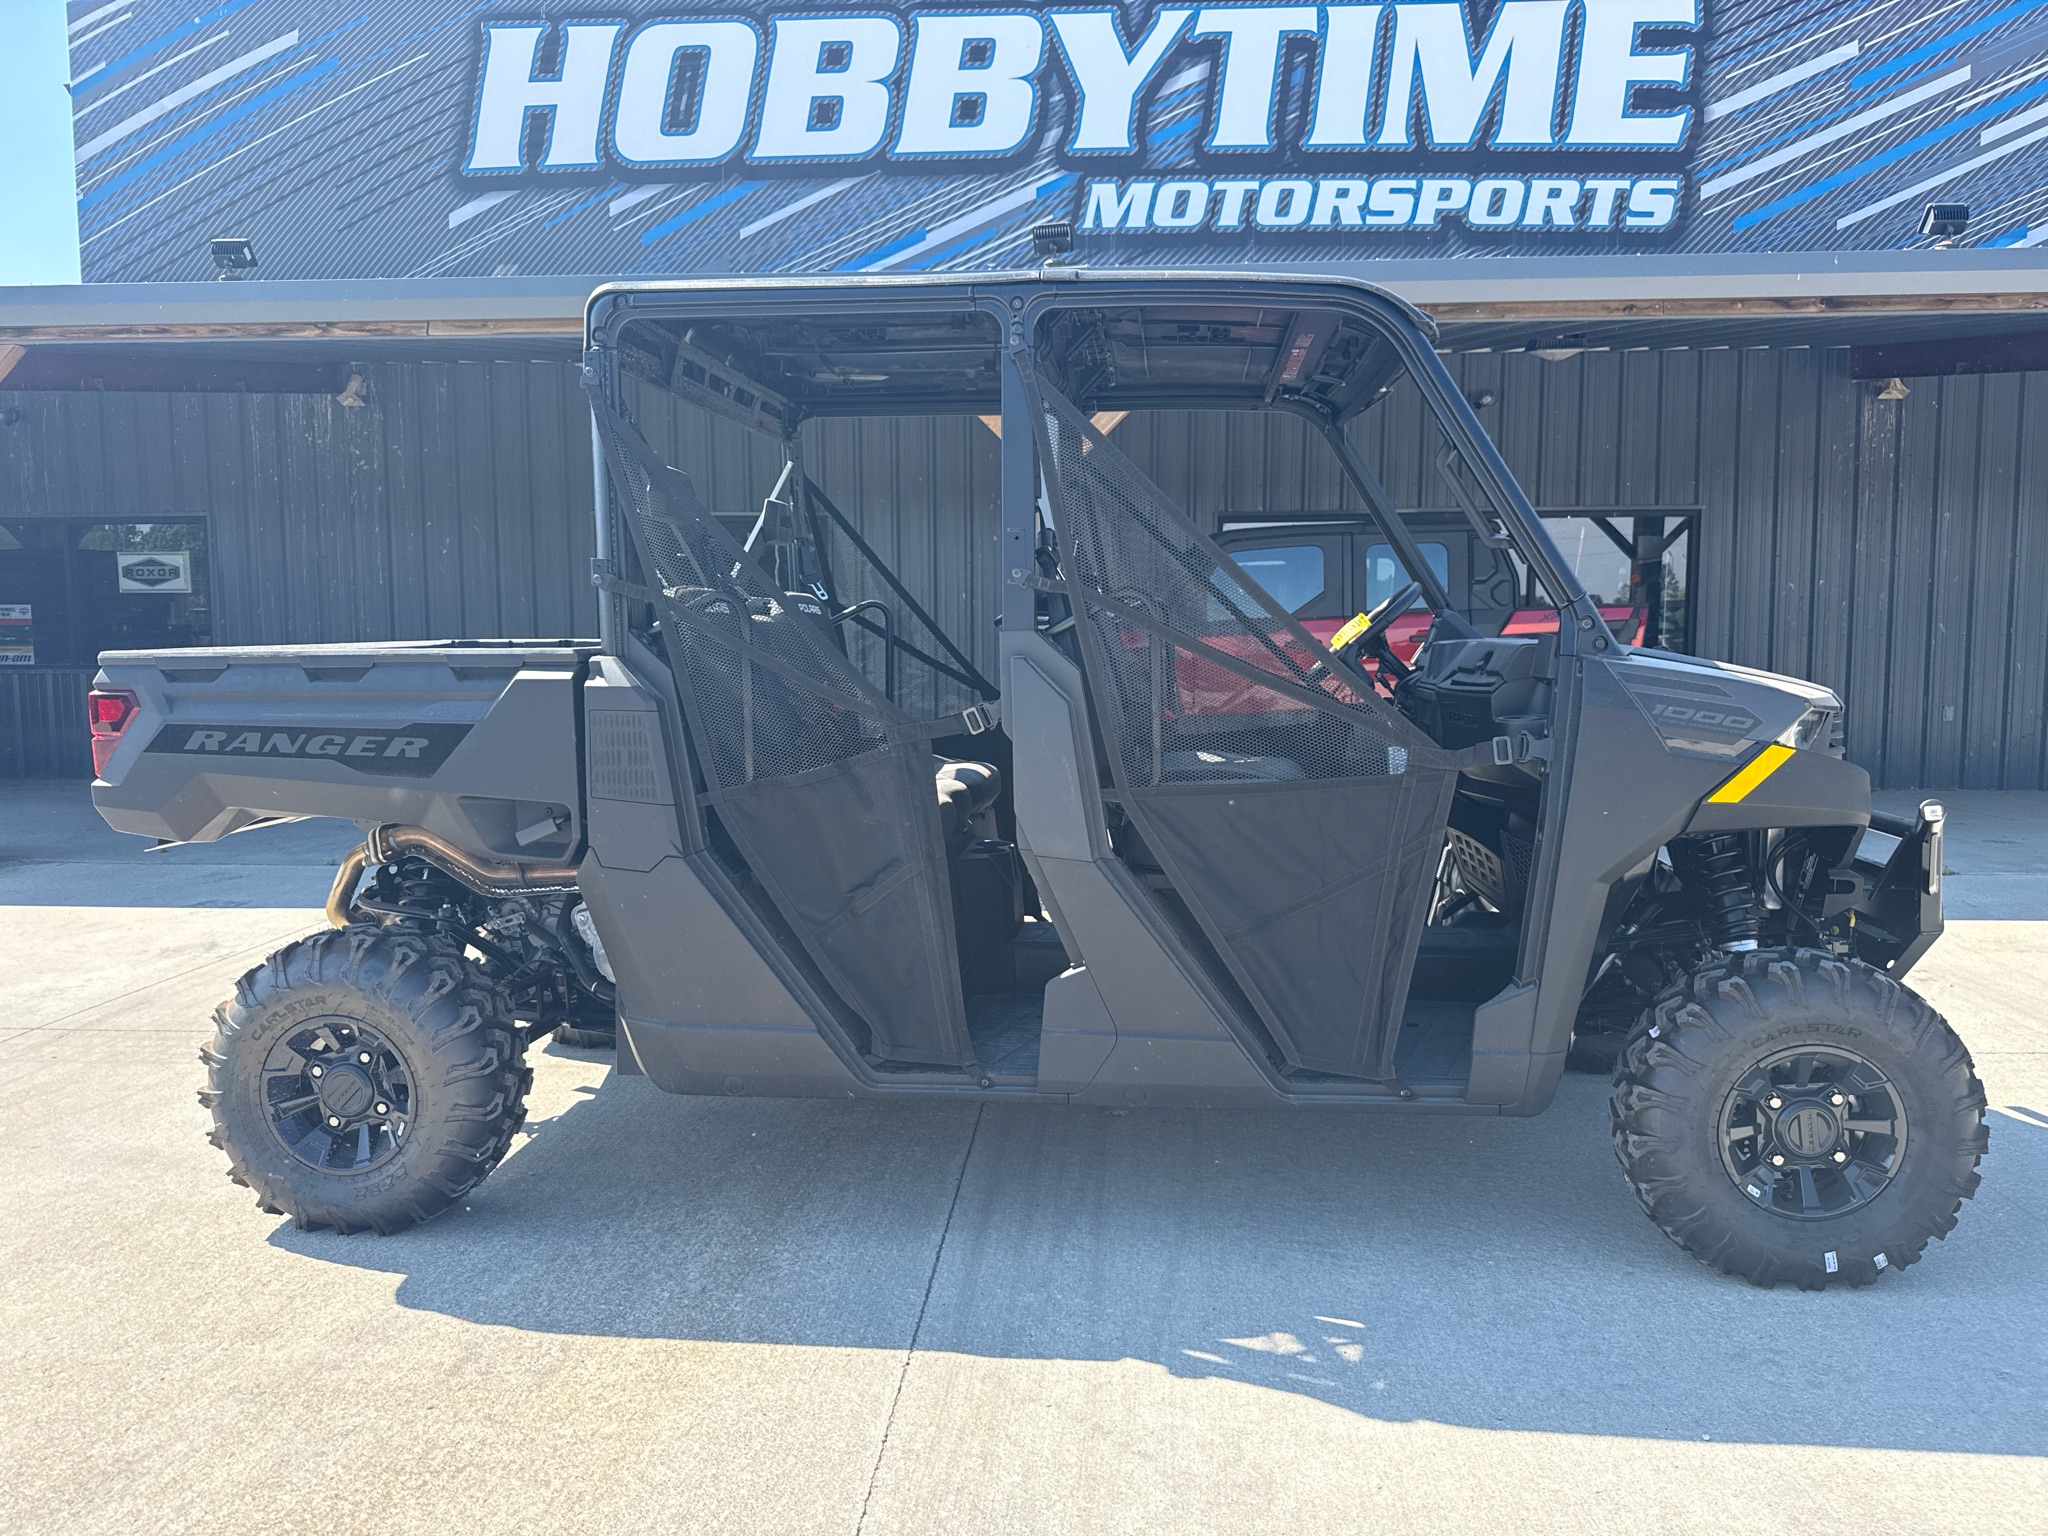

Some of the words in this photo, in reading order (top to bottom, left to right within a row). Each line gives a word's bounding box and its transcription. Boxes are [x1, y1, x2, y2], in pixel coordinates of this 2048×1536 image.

[463, 0, 1697, 170] HOBBYTIME
[1081, 179, 1681, 229] MOTORSPORTS
[125, 568, 178, 577] ROXOR
[0, 654, 31, 662] n-am
[1651, 704, 1755, 729] 1000
[184, 730, 429, 758] RANGER
[250, 995, 327, 1042] CARLSTAR
[1751, 1023, 1863, 1049] CARLSTAR
